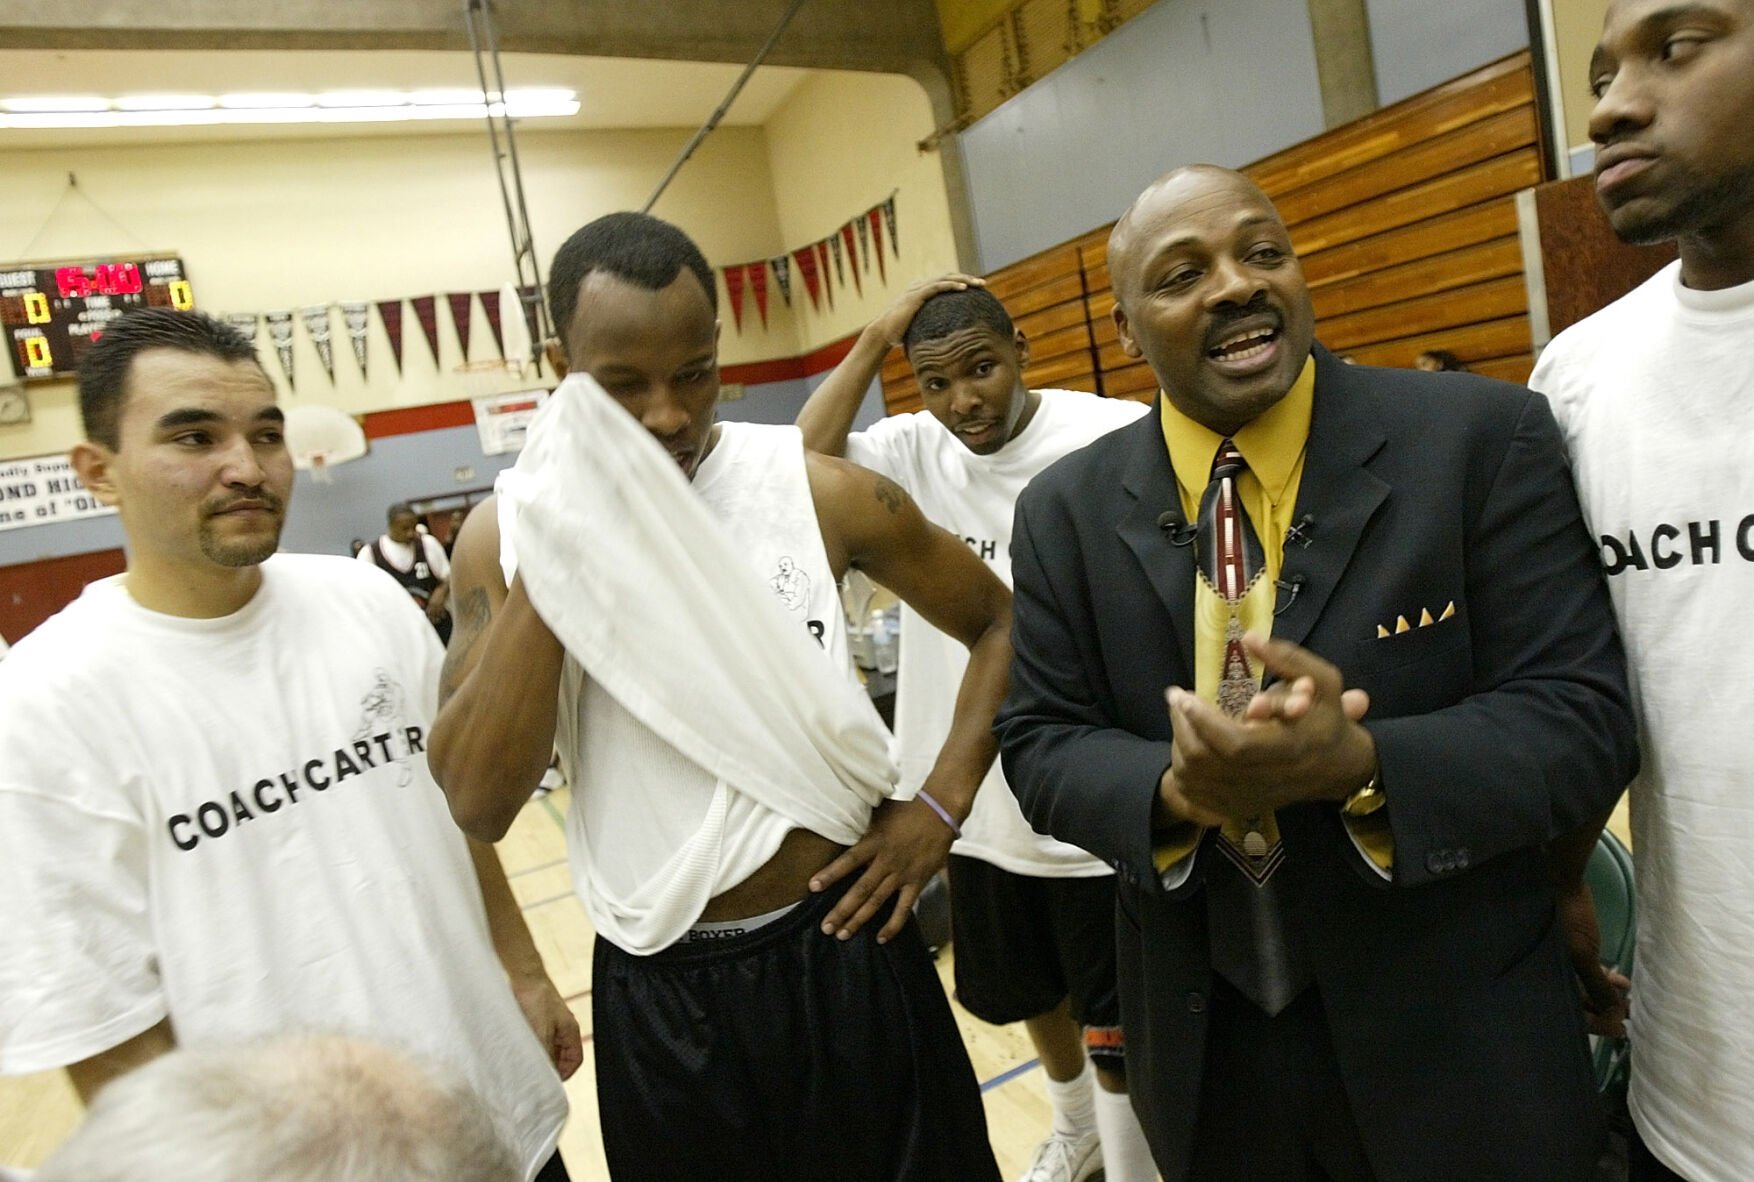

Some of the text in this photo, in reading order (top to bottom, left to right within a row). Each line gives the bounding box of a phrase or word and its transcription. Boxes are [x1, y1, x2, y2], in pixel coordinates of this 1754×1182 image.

[24, 292, 51, 324] 0
[168, 279, 193, 311] 0
[304, 726, 424, 792] CARTR
